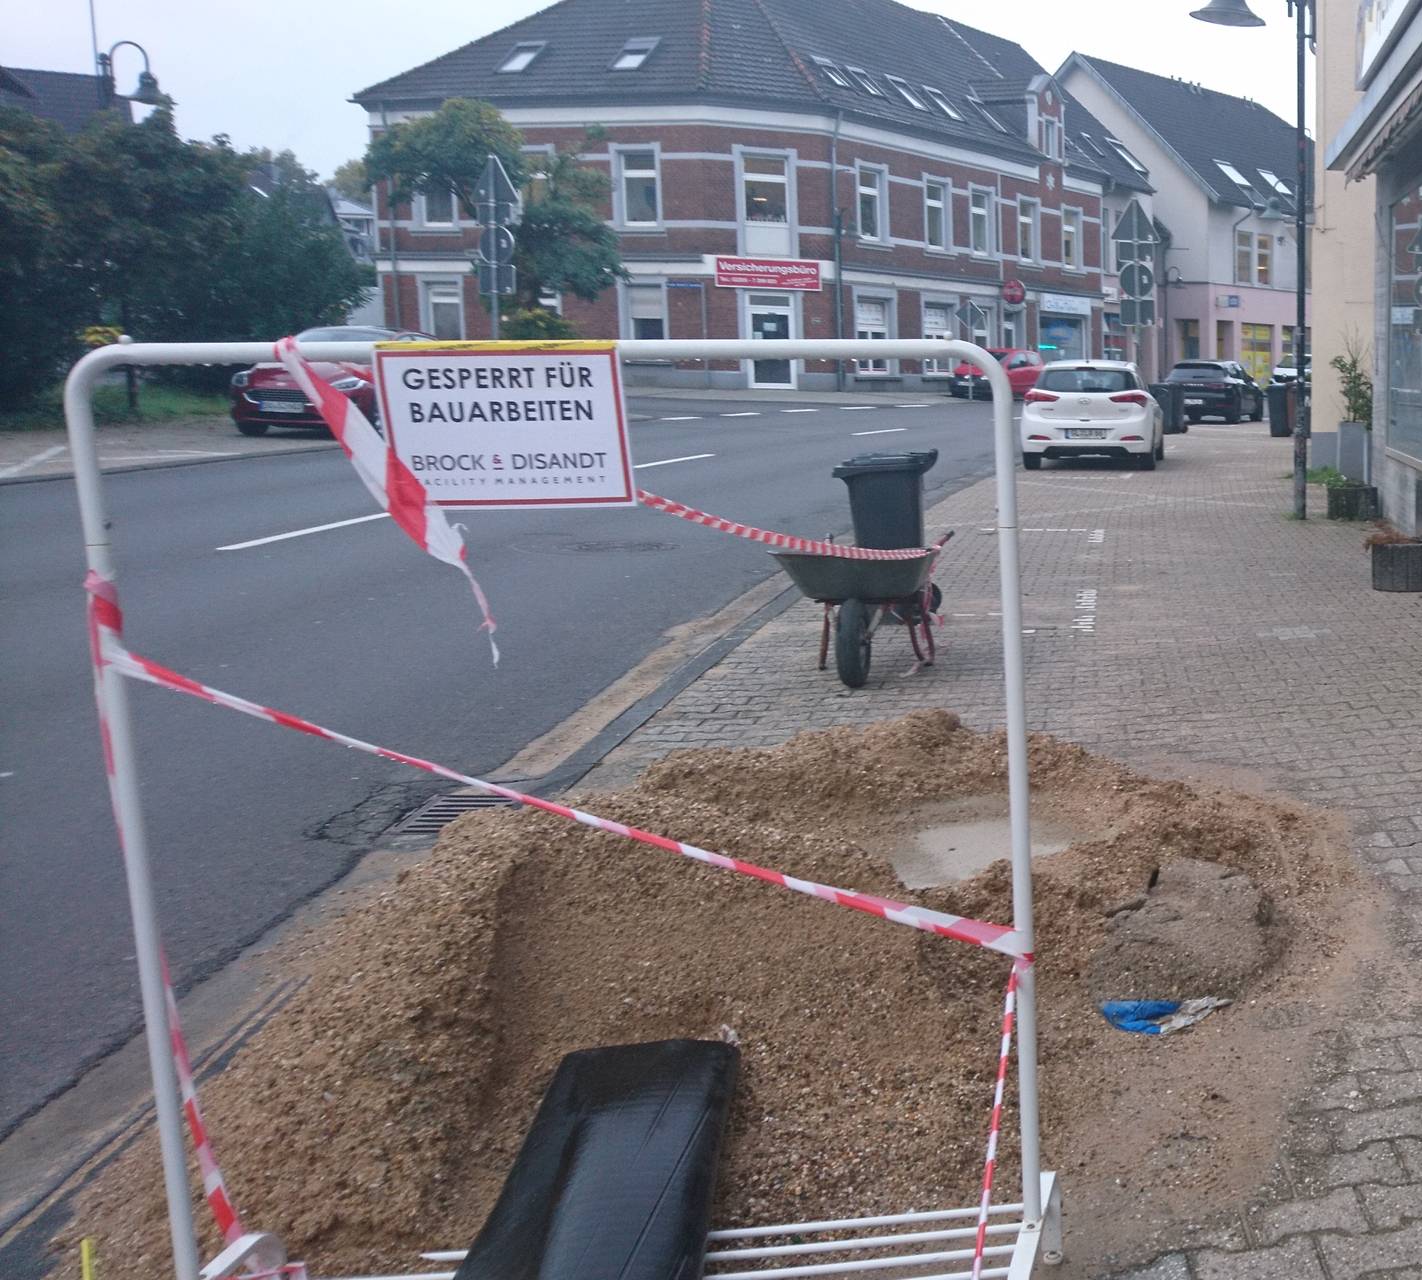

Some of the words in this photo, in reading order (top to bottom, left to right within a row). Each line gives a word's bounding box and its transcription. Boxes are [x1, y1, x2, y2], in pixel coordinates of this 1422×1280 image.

[718, 261, 817, 275] Versicherungsbüro
[402, 367, 535, 390] GESPERRT
[546, 362, 594, 388] FÜR
[408, 400, 594, 423] BAUARBEITEN
[411, 454, 486, 472] BROCK
[492, 454, 505, 470] &
[511, 452, 608, 470] DISANDT
[495, 475, 606, 486] MANAGEMENT
